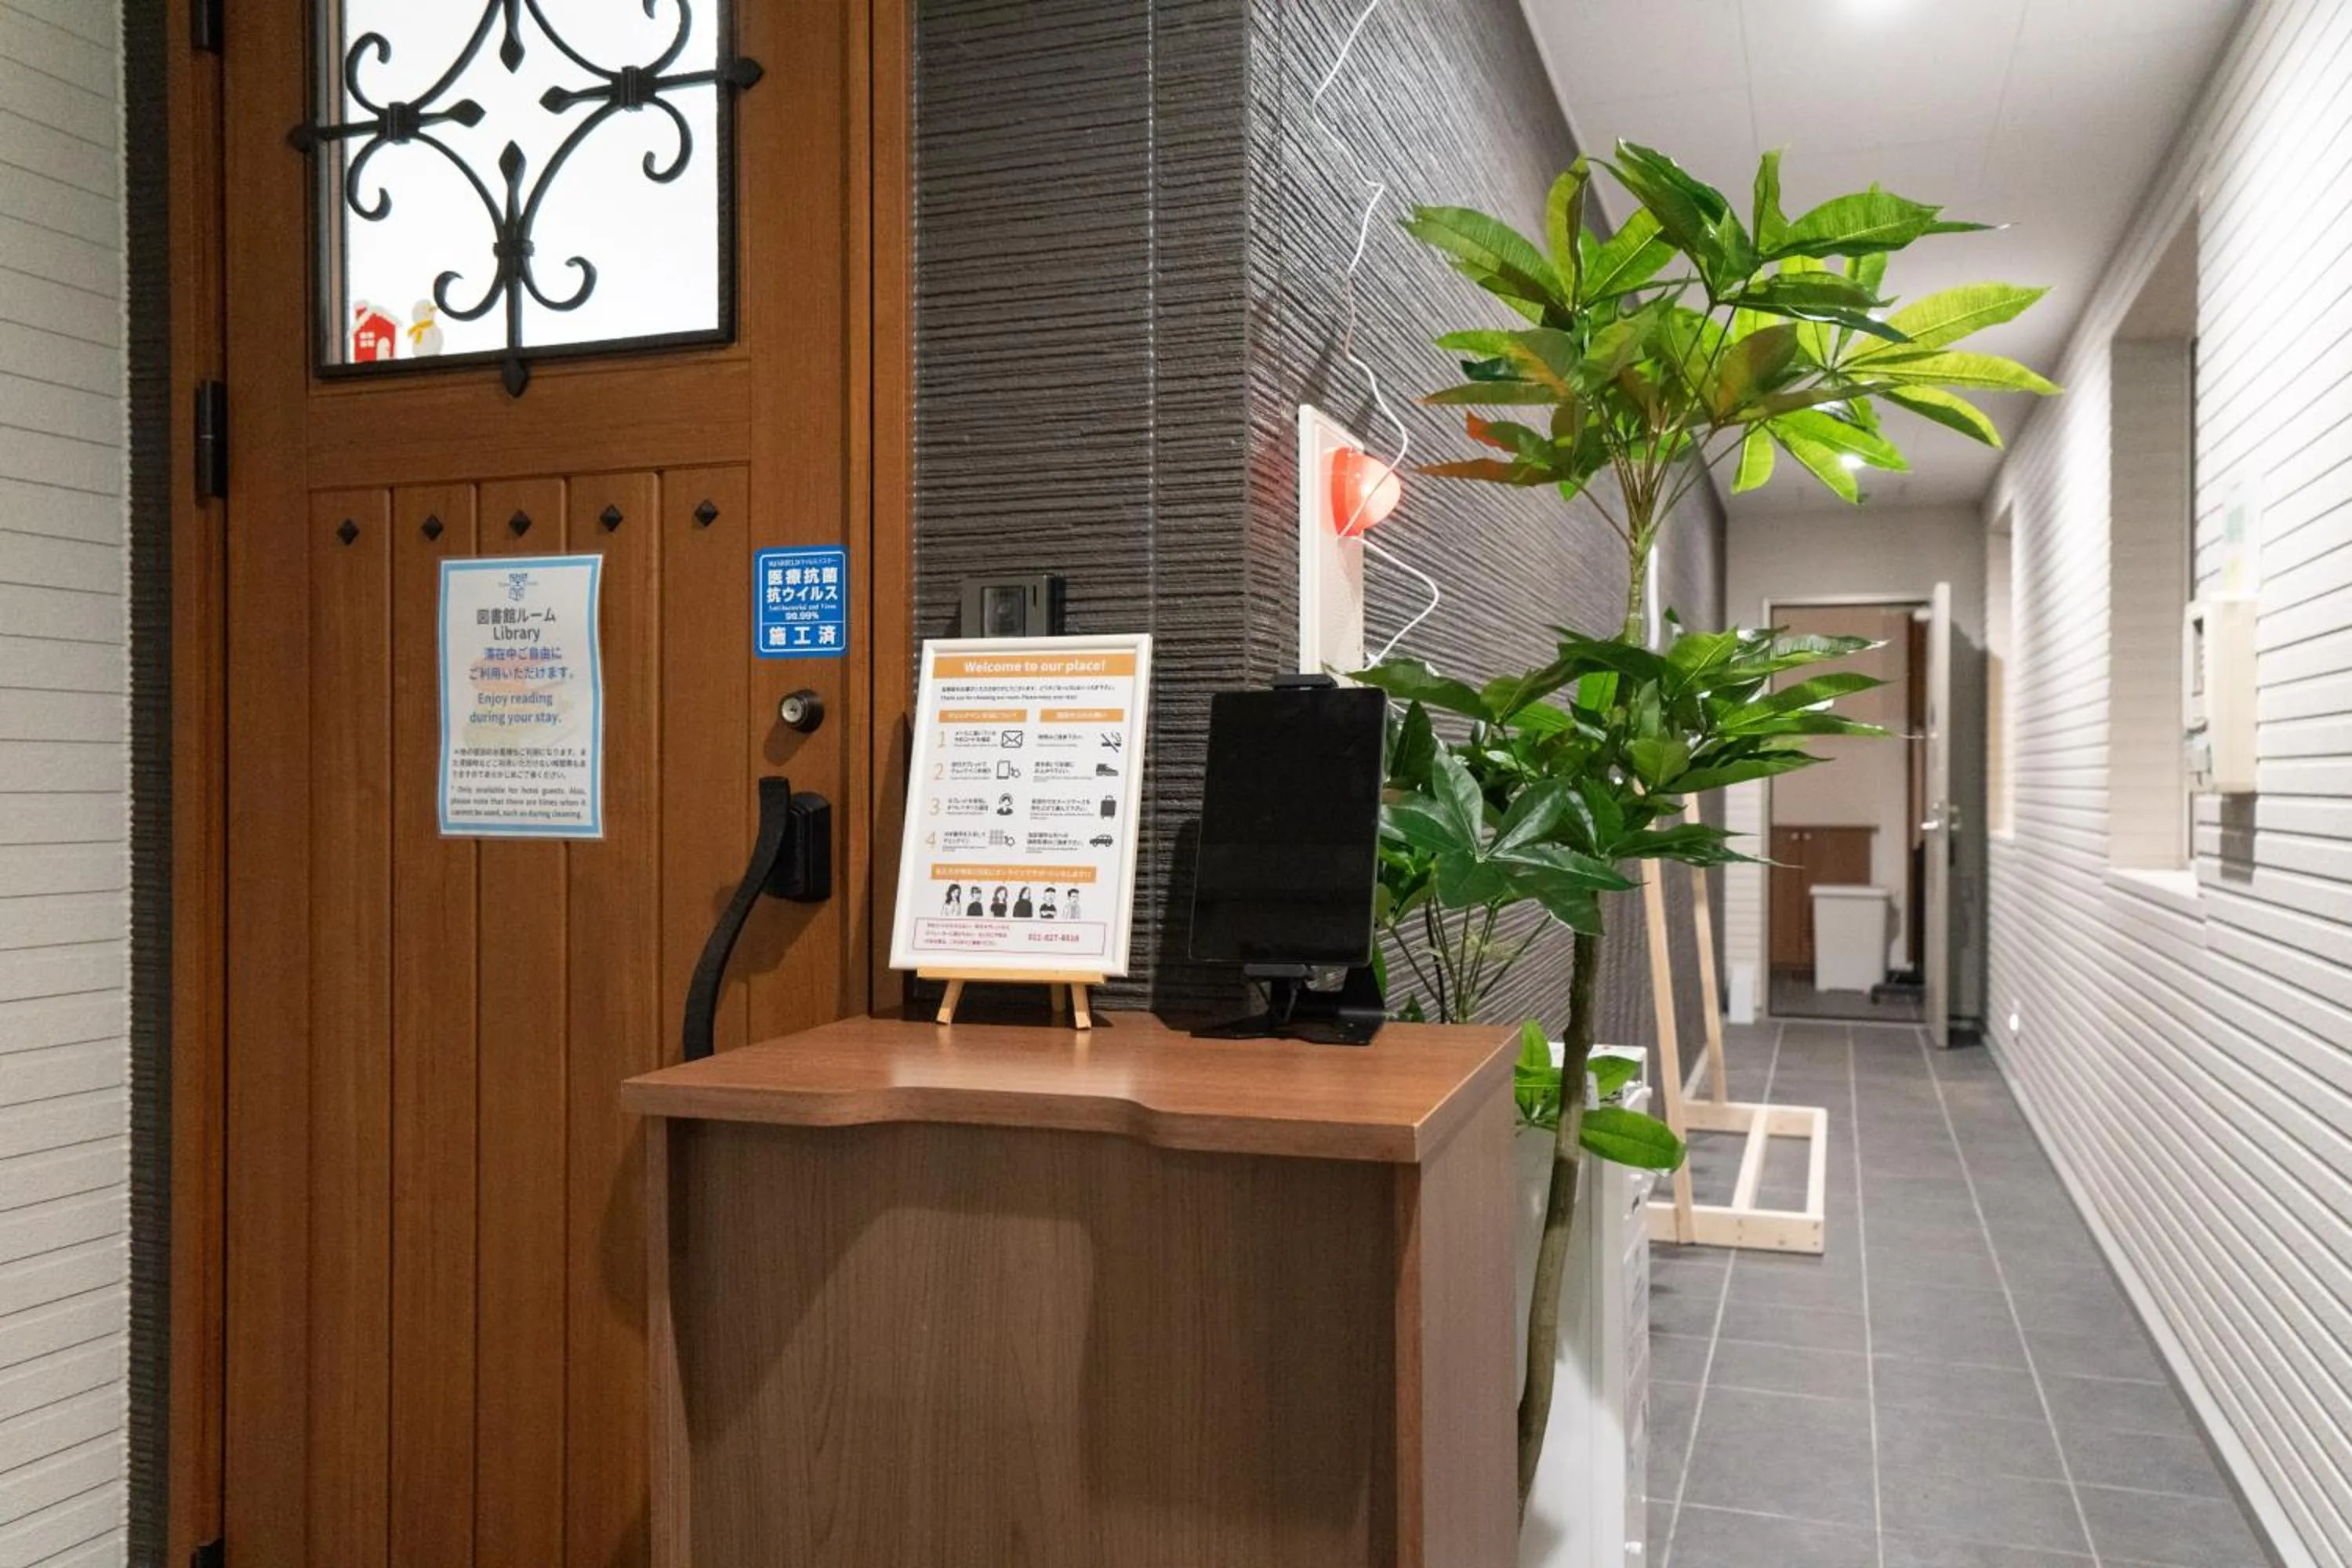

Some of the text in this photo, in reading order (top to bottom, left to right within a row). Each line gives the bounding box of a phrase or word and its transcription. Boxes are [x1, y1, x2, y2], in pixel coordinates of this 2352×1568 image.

[768, 567, 837, 586] 医療抗菌
[767, 586, 837, 604] 抗ウイルス
[476, 607, 557, 625] 図書館ルーム
[493, 626, 540, 642] Library
[484, 646, 562, 661] 滞在中ご自由に
[469, 666, 574, 681] ご利用いただけます。
[964, 659, 1106, 673] Welcome to our place!
[477, 691, 553, 707] Enjoy reading
[470, 711, 562, 726] during your stay.
[938, 730, 946, 748] 1
[934, 763, 945, 780] 2
[929, 797, 941, 816] 3
[925, 831, 936, 848] 4
